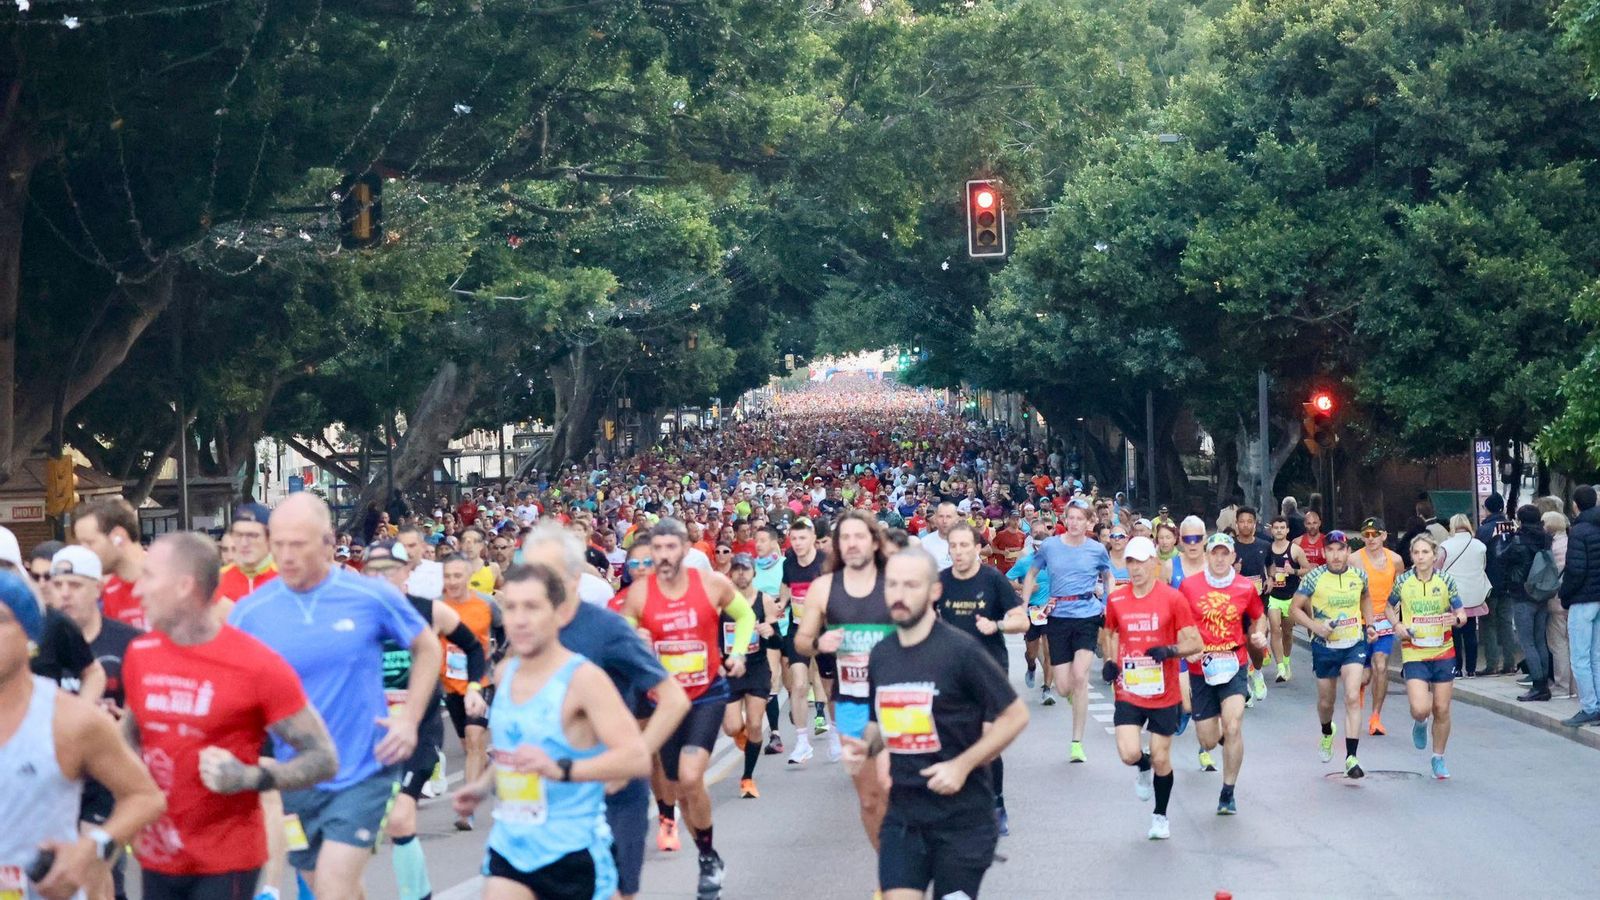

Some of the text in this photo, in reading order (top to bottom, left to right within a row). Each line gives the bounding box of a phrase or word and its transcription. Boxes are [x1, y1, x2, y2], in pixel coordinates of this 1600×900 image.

[1476, 441, 1491, 453] BUS
[1479, 467, 1490, 476] 31
[1480, 476, 1491, 485] 23
